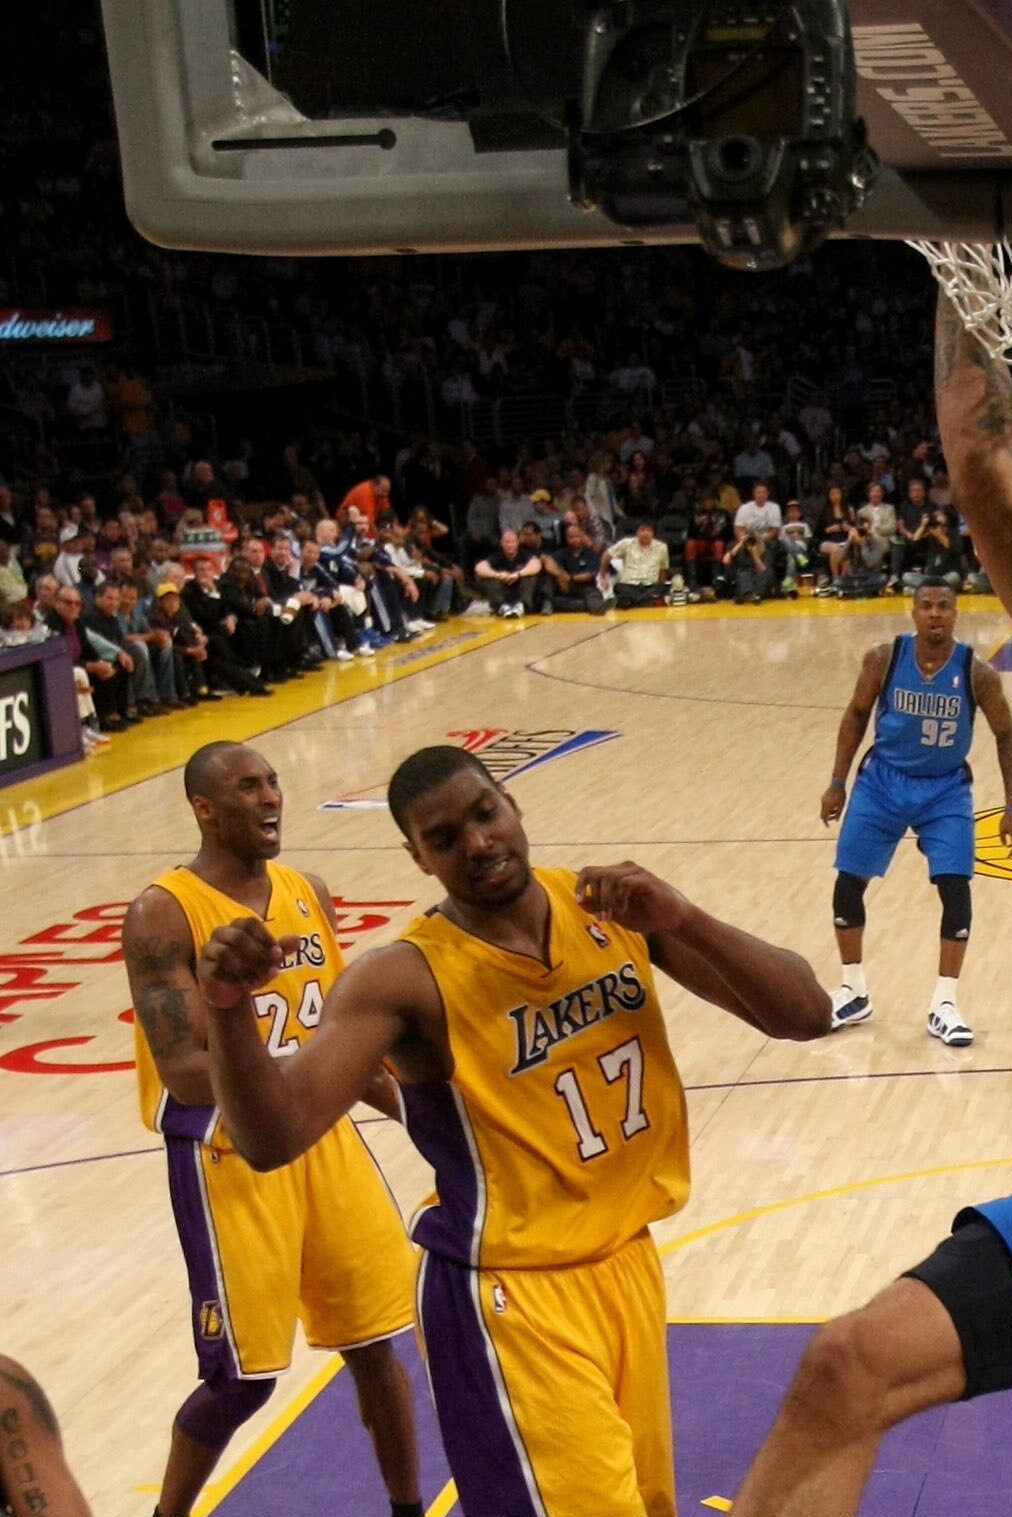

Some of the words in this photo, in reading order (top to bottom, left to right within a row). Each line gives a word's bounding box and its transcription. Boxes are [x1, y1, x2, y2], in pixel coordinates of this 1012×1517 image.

[895, 688, 961, 719] DALLAS
[921, 719, 958, 748] 92
[253, 980, 325, 1059] 24
[508, 962, 647, 1078] LAKERS
[554, 1035, 651, 1163] 17
